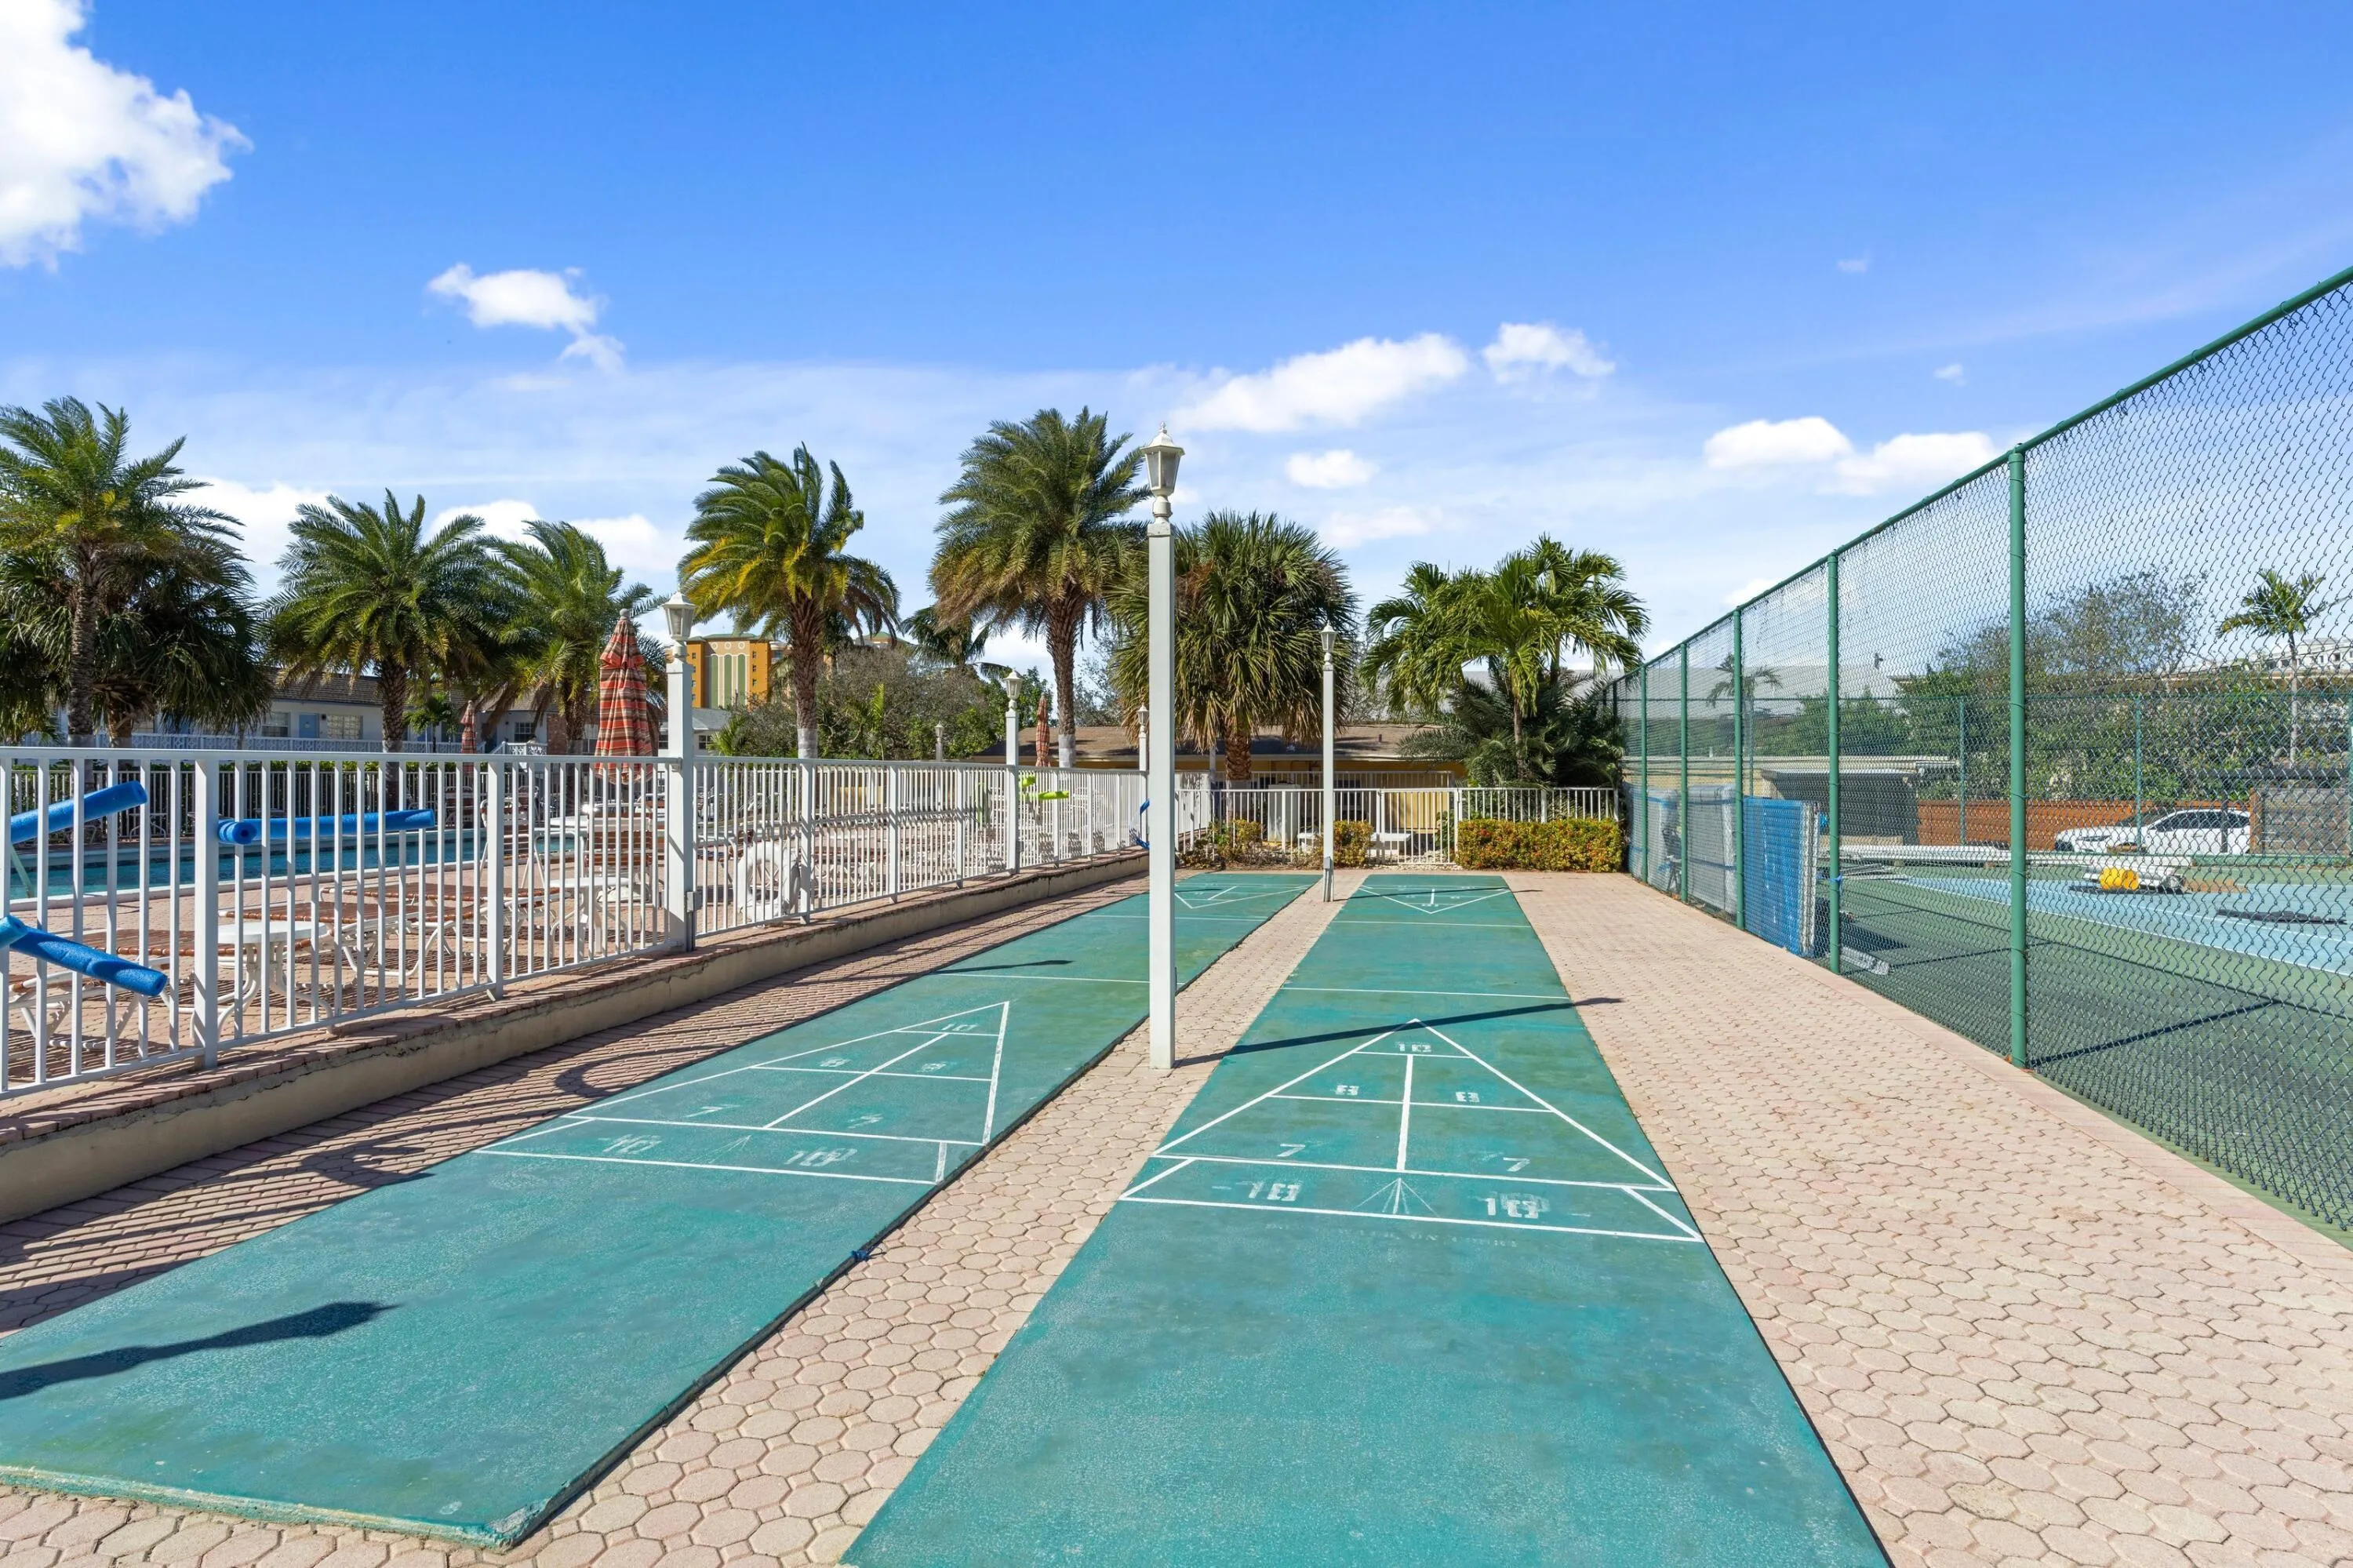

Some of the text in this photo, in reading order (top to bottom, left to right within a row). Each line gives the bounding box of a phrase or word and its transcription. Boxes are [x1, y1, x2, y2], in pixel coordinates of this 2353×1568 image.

[1396, 1042, 1432, 1053] 10
[1276, 1143, 1306, 1157] 7
[1502, 1157, 1530, 1172] 7
